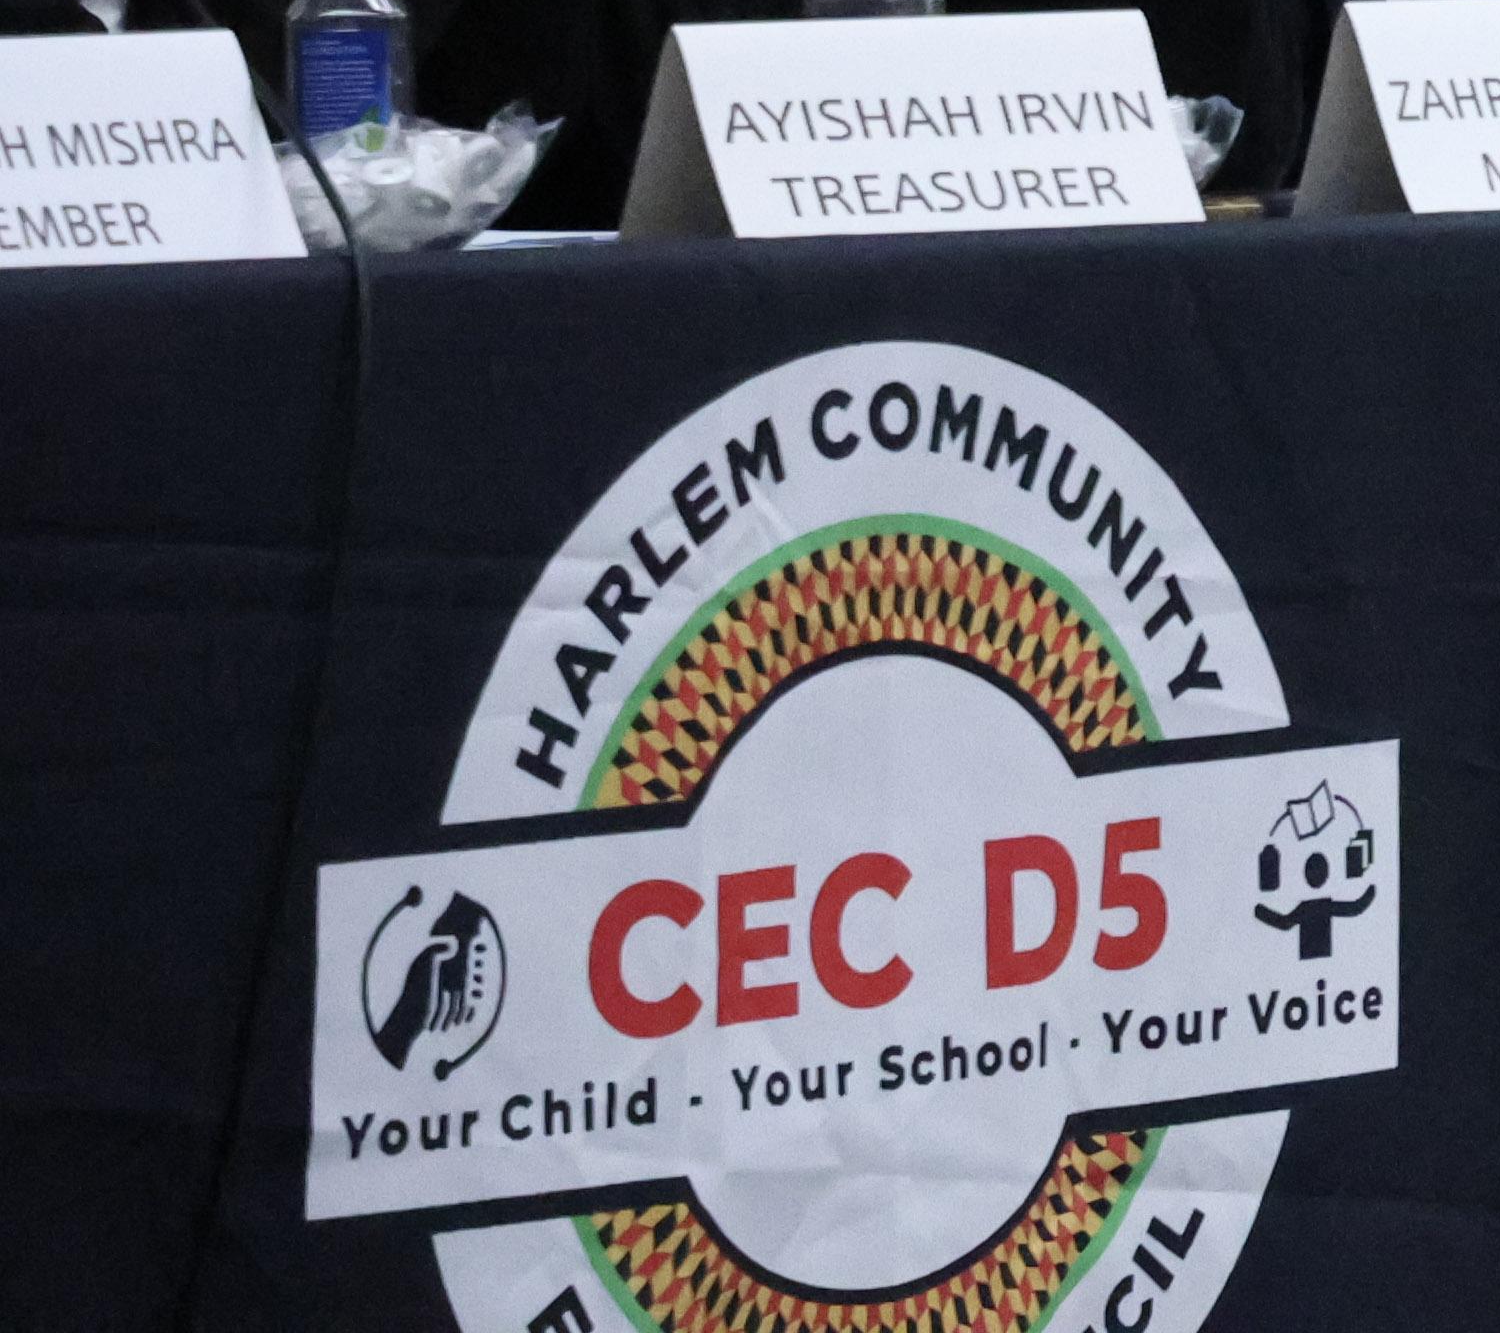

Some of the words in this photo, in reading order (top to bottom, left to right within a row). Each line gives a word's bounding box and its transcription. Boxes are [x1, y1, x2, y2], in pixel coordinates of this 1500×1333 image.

[47, 117, 246, 167] MISHRA
[725, 94, 981, 144] AYISHAH
[999, 90, 1156, 135] IRVIN
[772, 166, 1130, 218] TREASURER
[0, 202, 162, 250] EMBER
[516, 417, 786, 788] HARLEM
[811, 382, 1222, 700] COMMUNITY
[587, 851, 913, 1039] CEC
[984, 817, 1168, 991] D5
[343, 1111, 480, 1159] Your
[501, 1077, 657, 1140] Child
[732, 1061, 855, 1111] Your
[879, 1022, 1047, 1090] School
[1102, 1006, 1229, 1053] Your
[1248, 979, 1384, 1034] Voice
